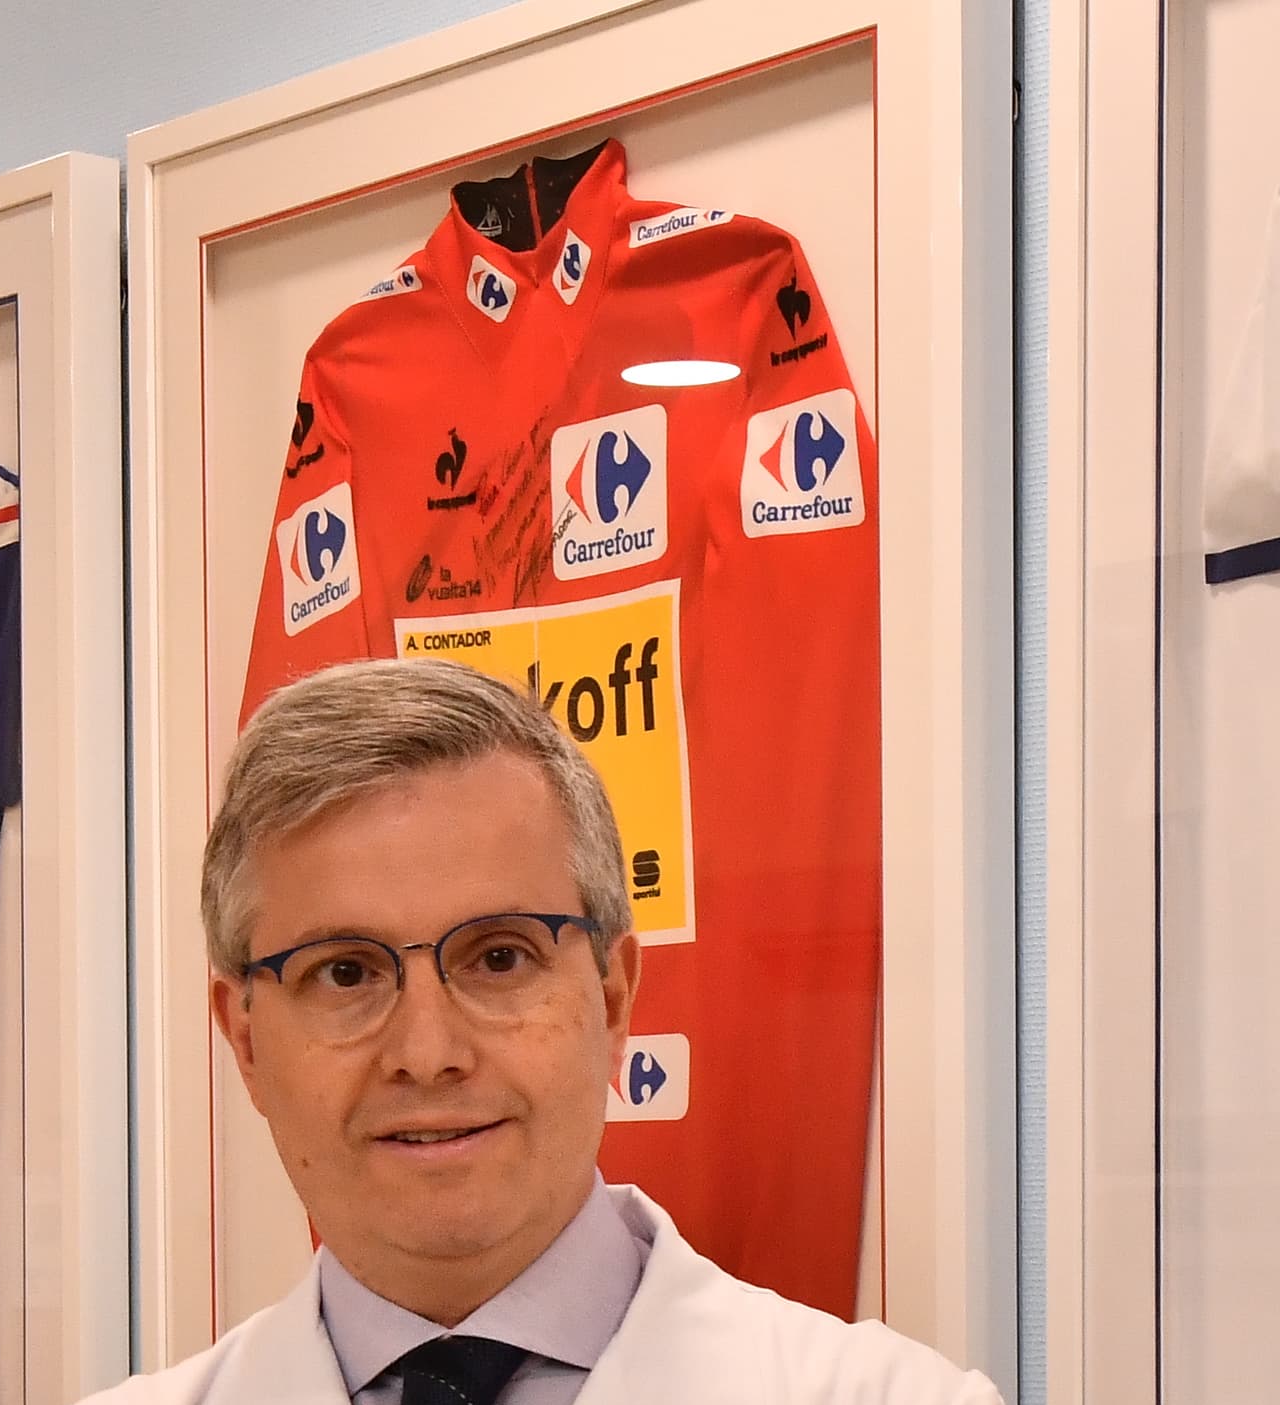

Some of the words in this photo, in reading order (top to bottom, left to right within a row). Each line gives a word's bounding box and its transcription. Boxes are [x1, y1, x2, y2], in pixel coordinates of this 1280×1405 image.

[637, 214, 698, 241] Carrefour
[752, 494, 853, 524] Carrefour
[563, 527, 655, 566] Carrefour
[291, 576, 351, 623] Carrefour
[423, 630, 492, 651] CONTADOR
[527, 636, 660, 743] koff
